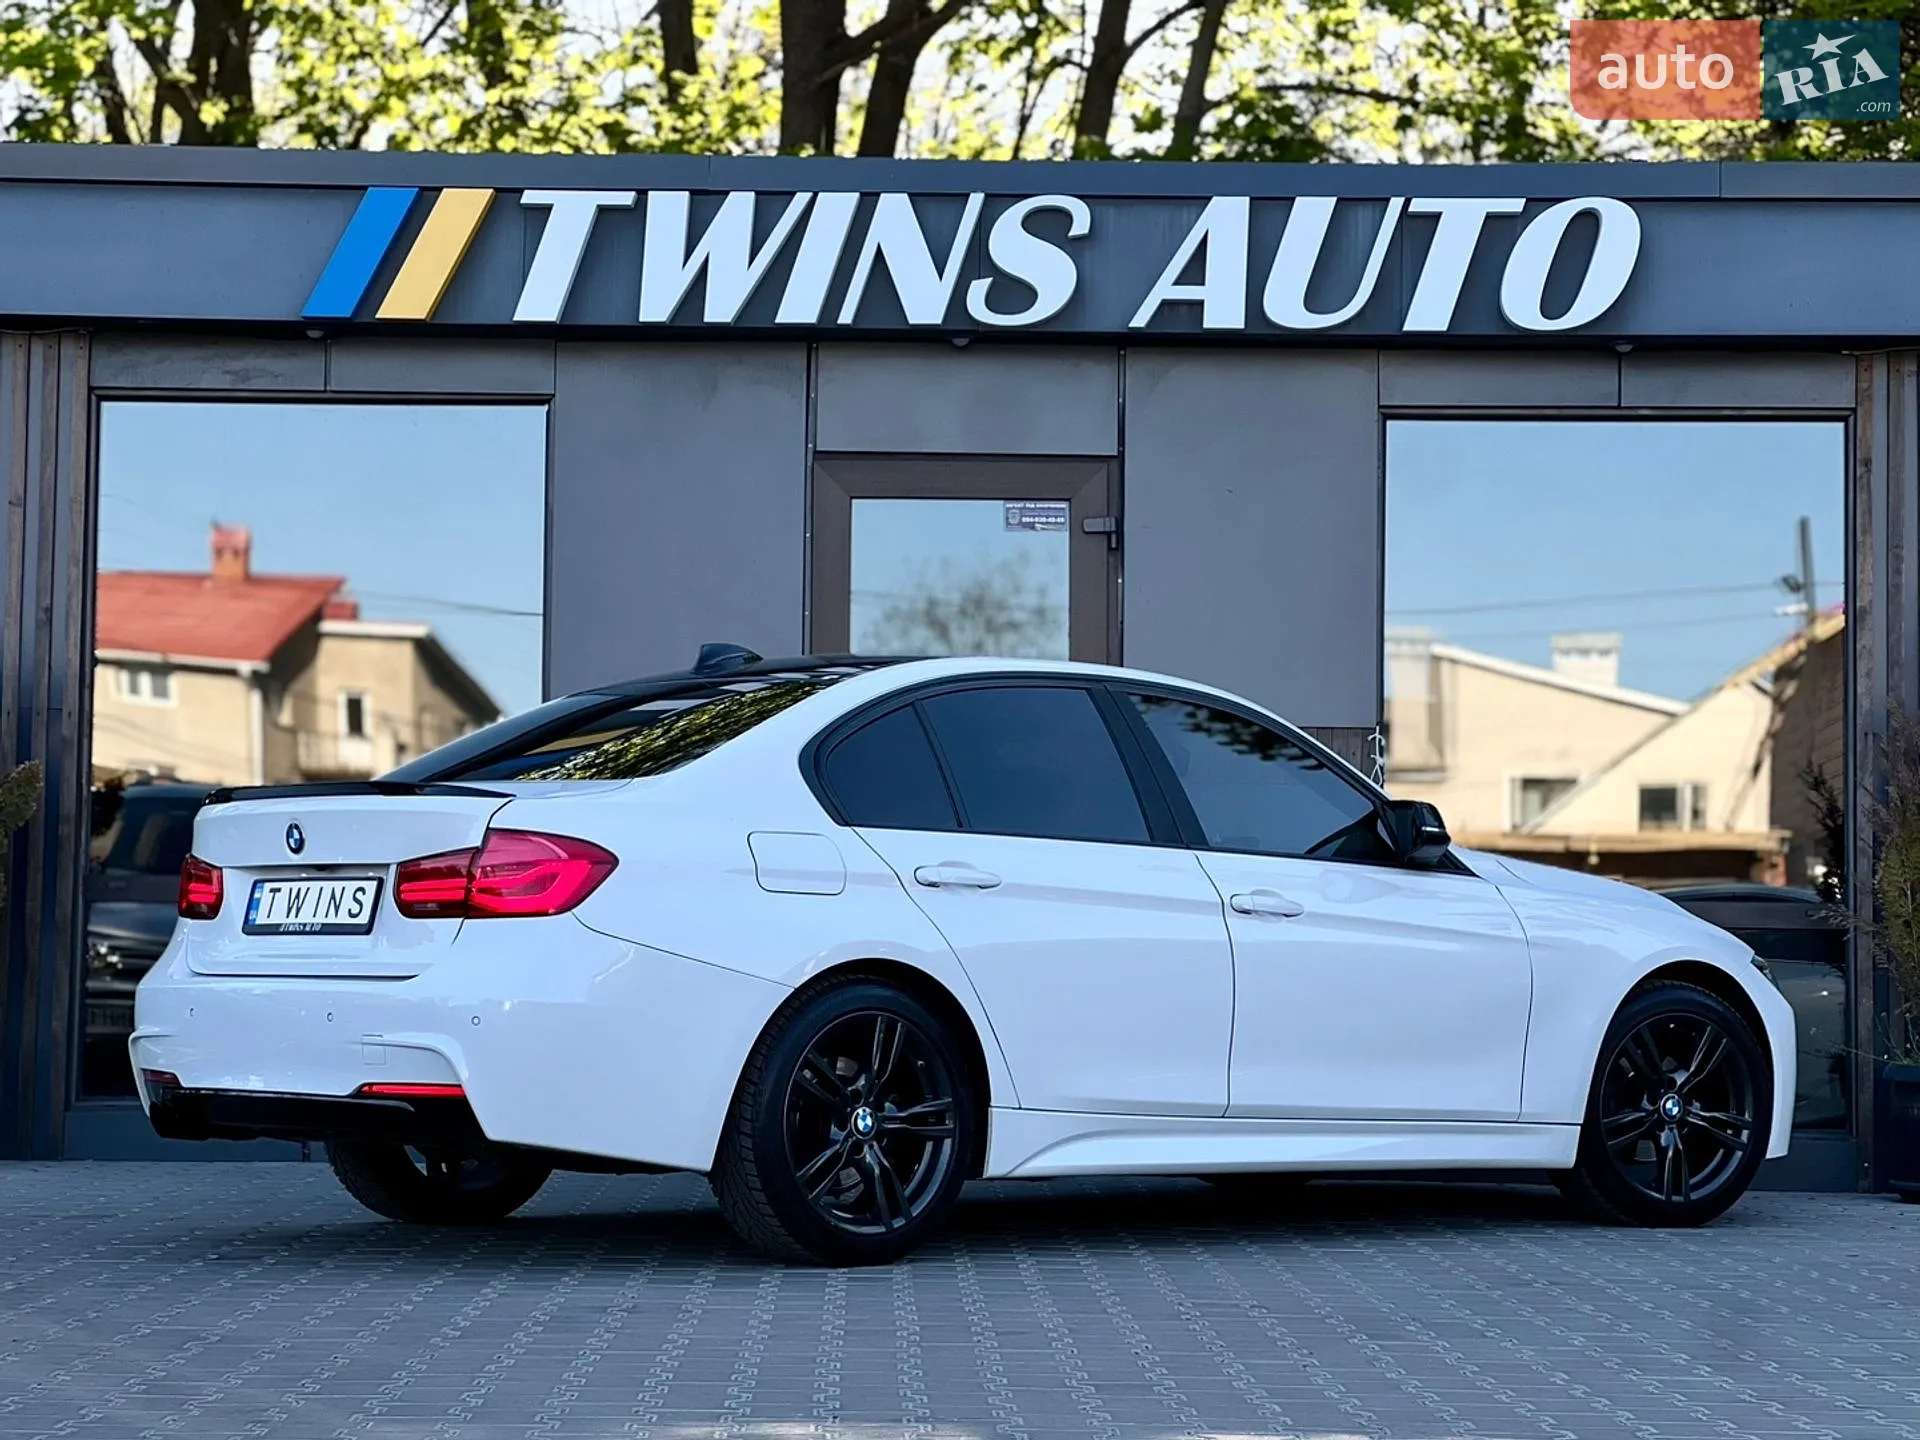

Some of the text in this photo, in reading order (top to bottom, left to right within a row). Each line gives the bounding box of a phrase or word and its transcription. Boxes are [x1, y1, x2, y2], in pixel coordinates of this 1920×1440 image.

[512, 190, 1642, 333] TWINS AUTO
[266, 886, 367, 919] TWINS
